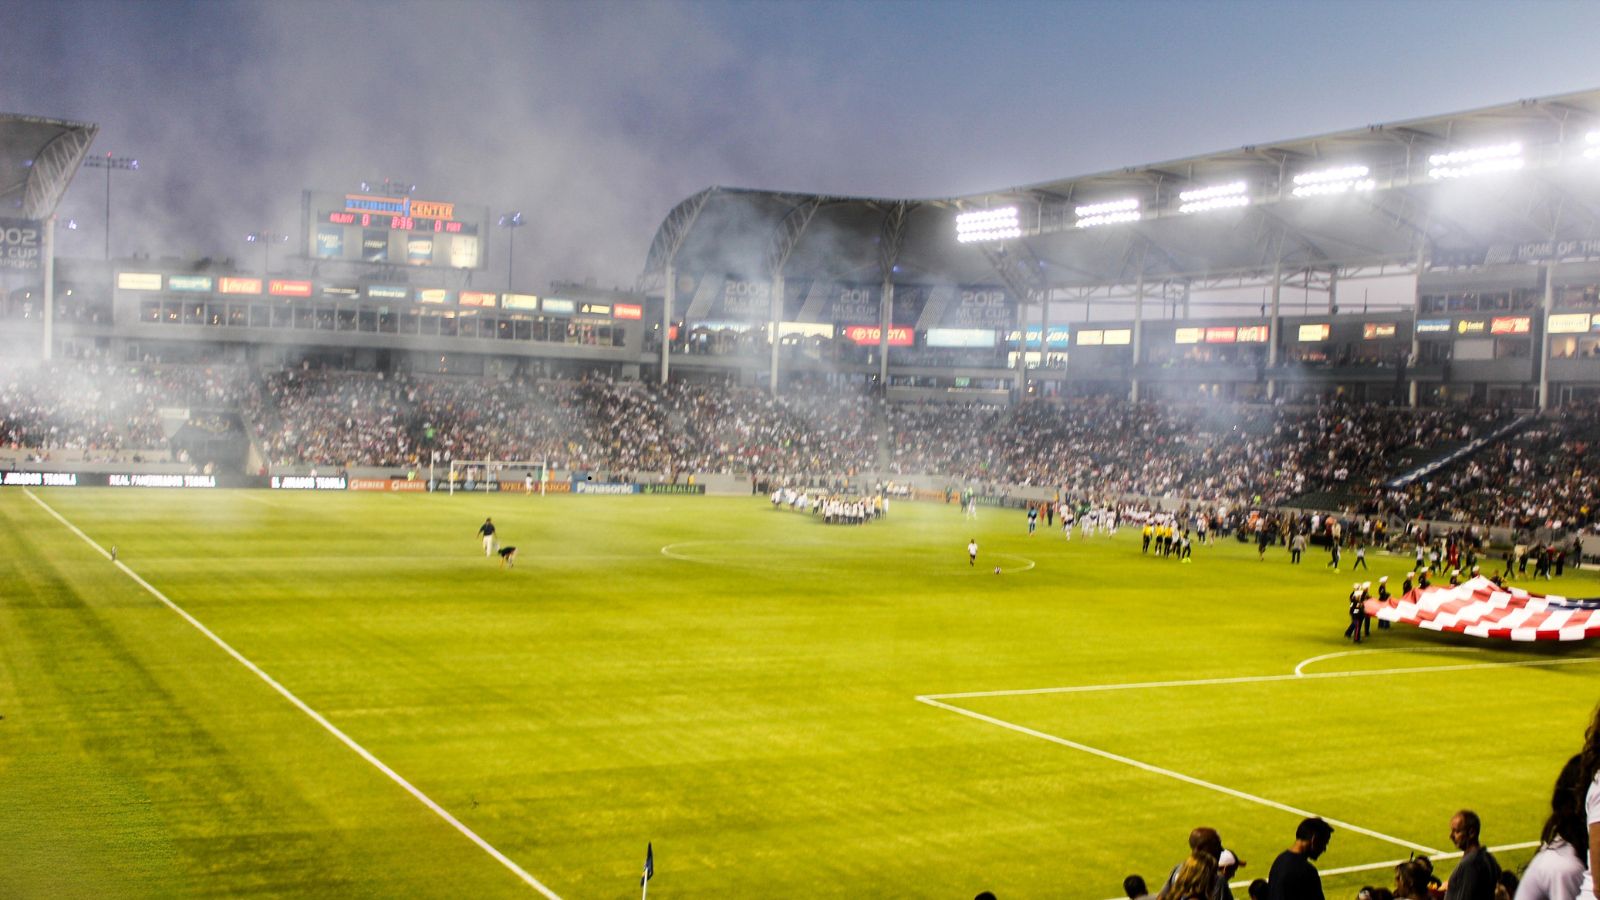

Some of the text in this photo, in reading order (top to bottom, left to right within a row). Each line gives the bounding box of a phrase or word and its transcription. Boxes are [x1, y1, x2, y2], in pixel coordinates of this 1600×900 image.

[410, 203, 454, 219] CENTER
[961, 291, 1005, 307] 2012
[868, 328, 907, 340] TOOTA
[539, 482, 571, 492] ARGO
[576, 482, 634, 493] Panasonic
[654, 485, 700, 495] HERBALIFE
